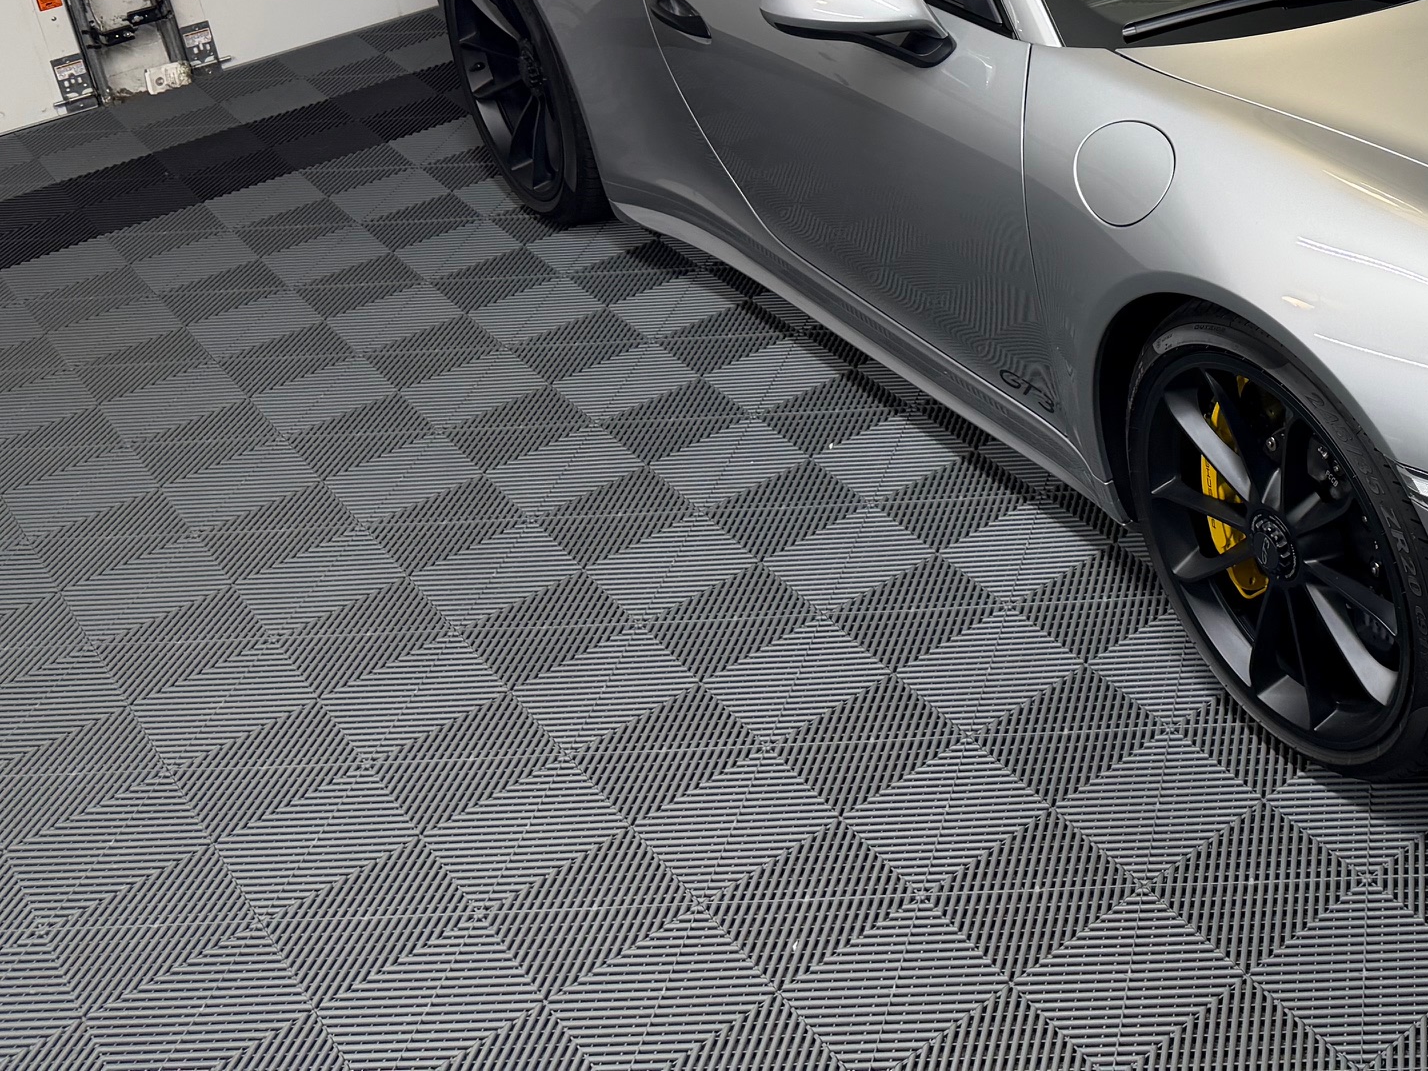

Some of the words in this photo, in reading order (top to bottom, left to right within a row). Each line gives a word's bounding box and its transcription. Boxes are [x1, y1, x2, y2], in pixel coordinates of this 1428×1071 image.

[1000, 369, 1055, 414] GT3
[1325, 469, 1340, 487] PCCB
[1379, 504, 1422, 597] ZR20
